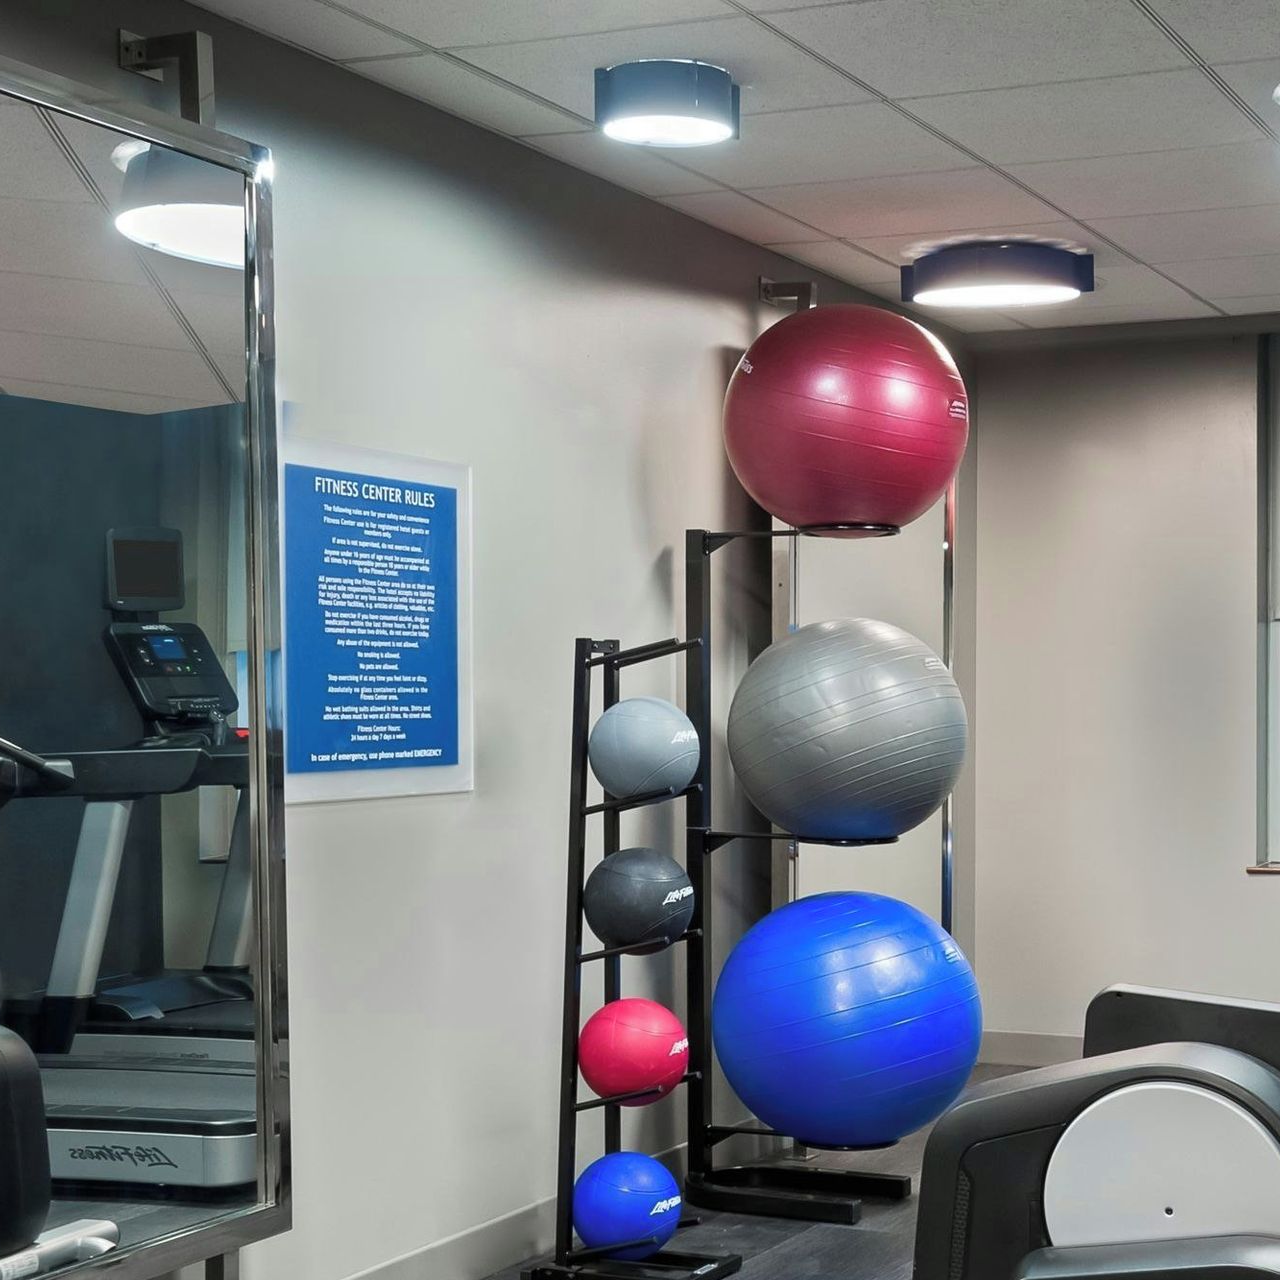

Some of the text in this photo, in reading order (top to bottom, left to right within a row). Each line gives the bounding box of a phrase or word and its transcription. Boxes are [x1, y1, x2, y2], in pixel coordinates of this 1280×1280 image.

[315, 476, 434, 508] FITNESS CENTER RULES
